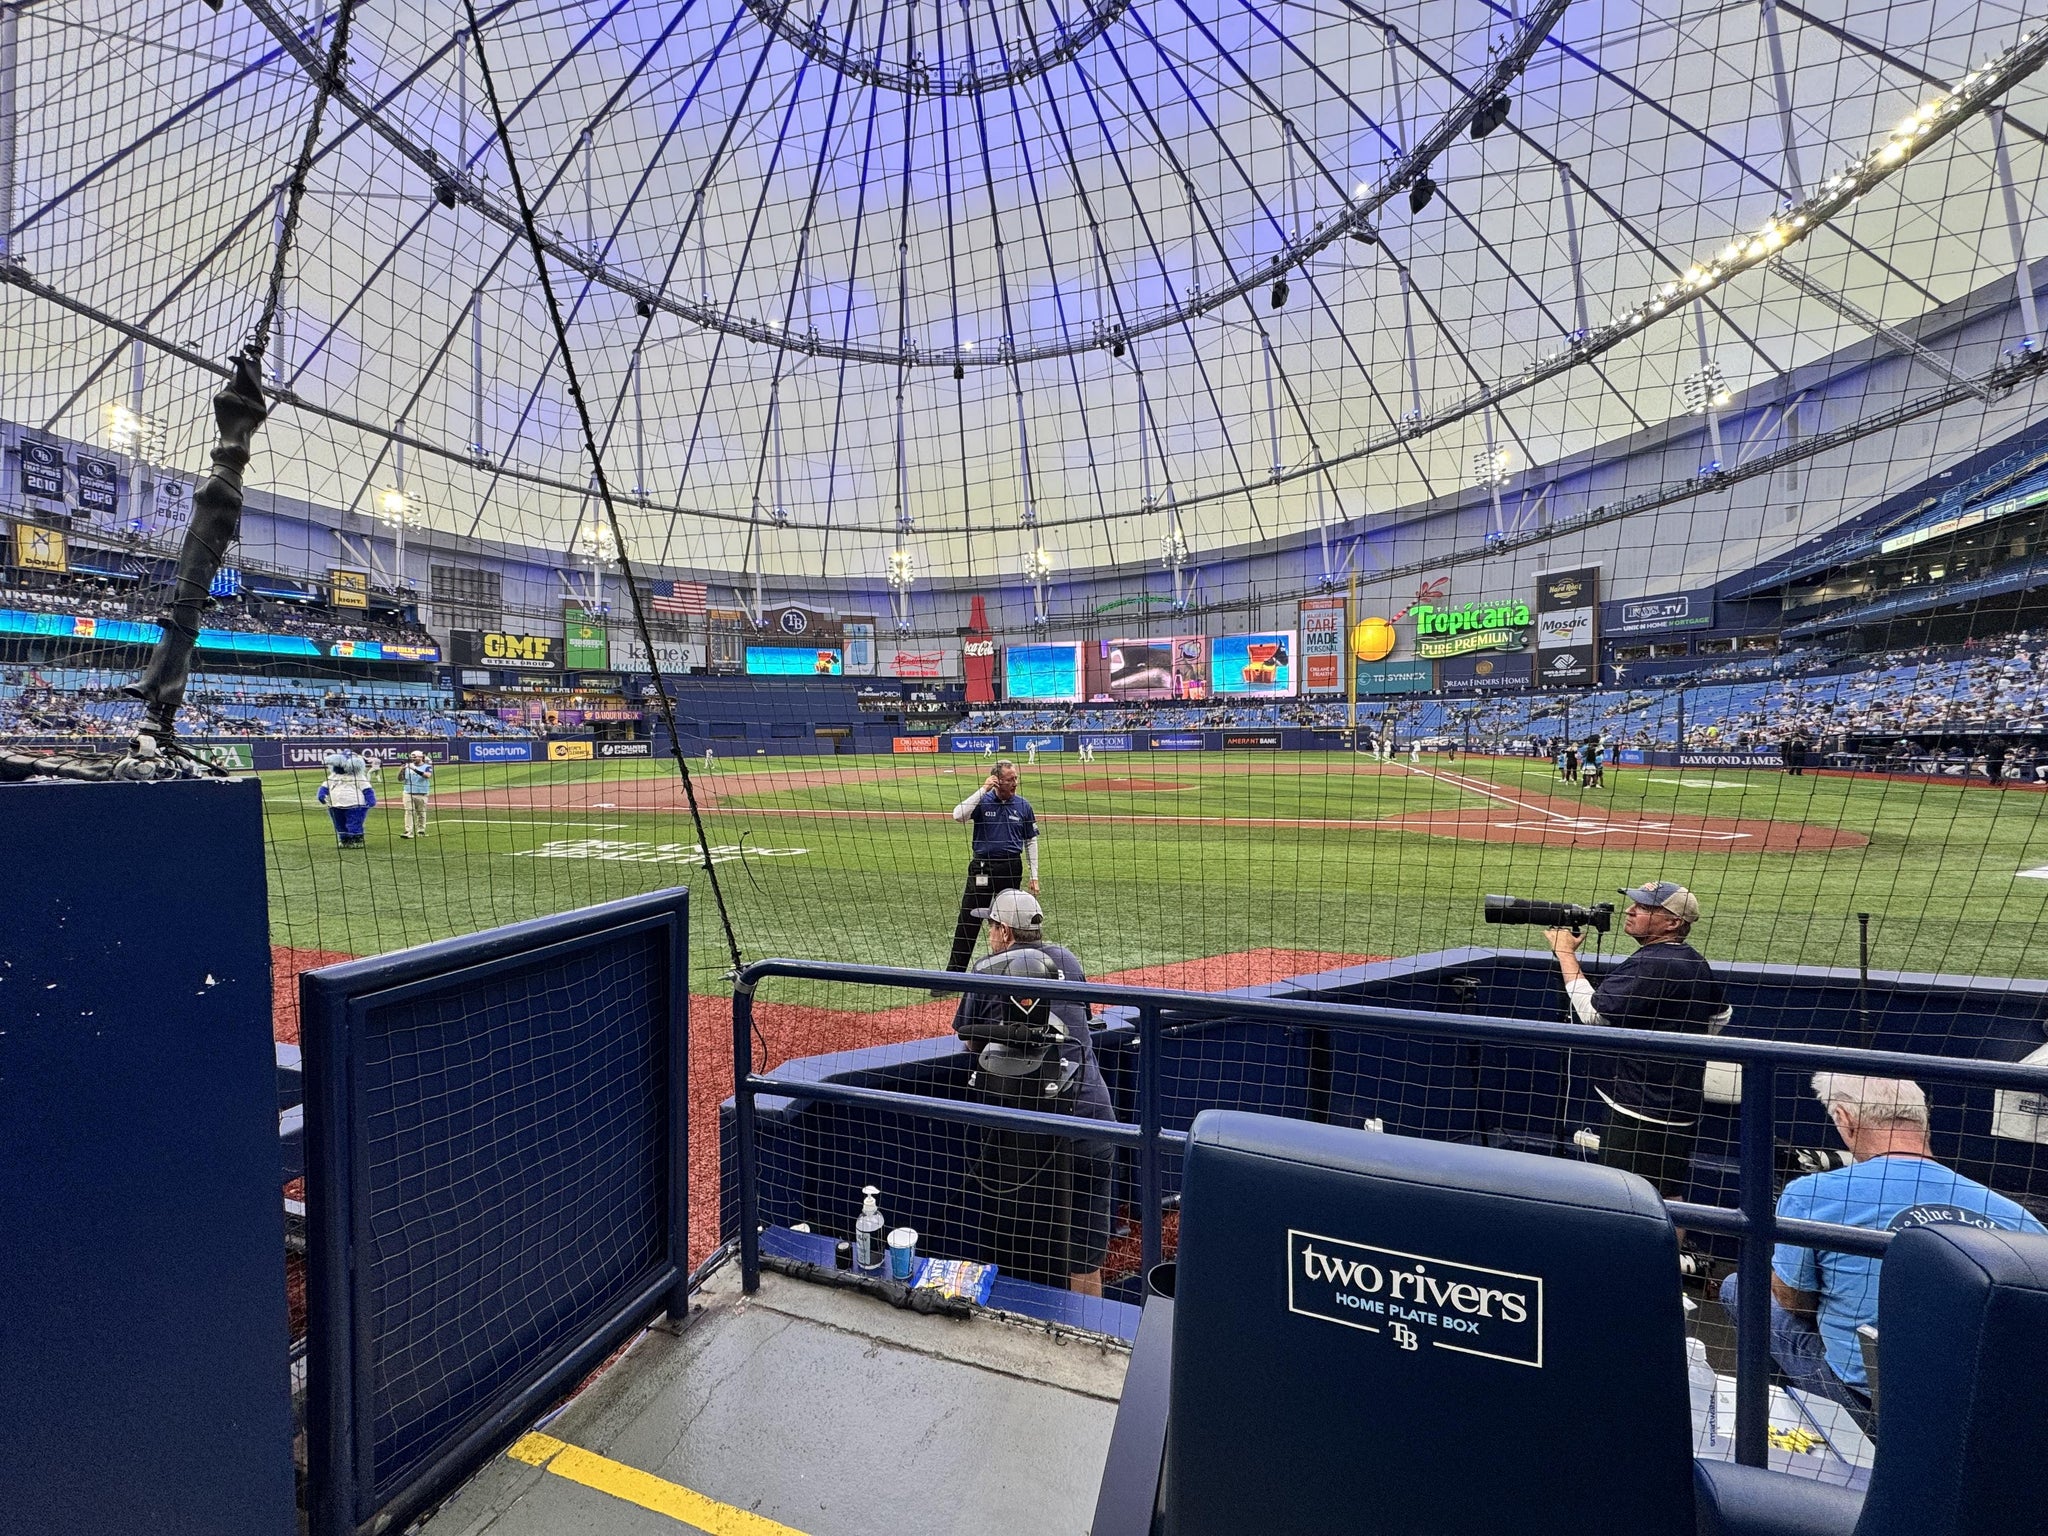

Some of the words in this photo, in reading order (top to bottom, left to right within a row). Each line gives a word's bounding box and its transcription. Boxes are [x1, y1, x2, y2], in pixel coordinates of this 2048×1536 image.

[28, 475, 57, 491] 2010
[83, 489, 113, 505] 2020
[158, 507, 186, 522] 2020
[785, 613, 803, 630] TB
[1307, 618, 1338, 633] CARE
[1409, 603, 1530, 635] Tropicana
[1542, 616, 1588, 631] Mosaic
[1307, 632, 1338, 645] MADE
[1421, 642, 1453, 655] PURE
[1454, 631, 1513, 649] PREMIUM
[484, 633, 551, 660] GMF
[1307, 645, 1338, 653] PERSONAL
[1373, 674, 1385, 683] TD
[1444, 680, 1468, 688] DREAM
[1470, 678, 1500, 687] FINDERS
[1501, 677, 1529, 685] HOMES
[595, 711, 622, 720] DAIQUIRI
[623, 711, 638, 720] DECK
[474, 745, 524, 757] Spectrum
[1679, 755, 1741, 765] RAYMOND
[1741, 756, 1784, 766] JAMES
[1910, 1207, 1953, 1226] Blue
[1301, 1243, 1384, 1293] two
[1389, 1264, 1528, 1324] rivers
[1335, 1292, 1385, 1315] HOME
[1389, 1304, 1438, 1326] PLATE
[1442, 1316, 1480, 1335] BOX
[1388, 1321, 1419, 1351] TB
